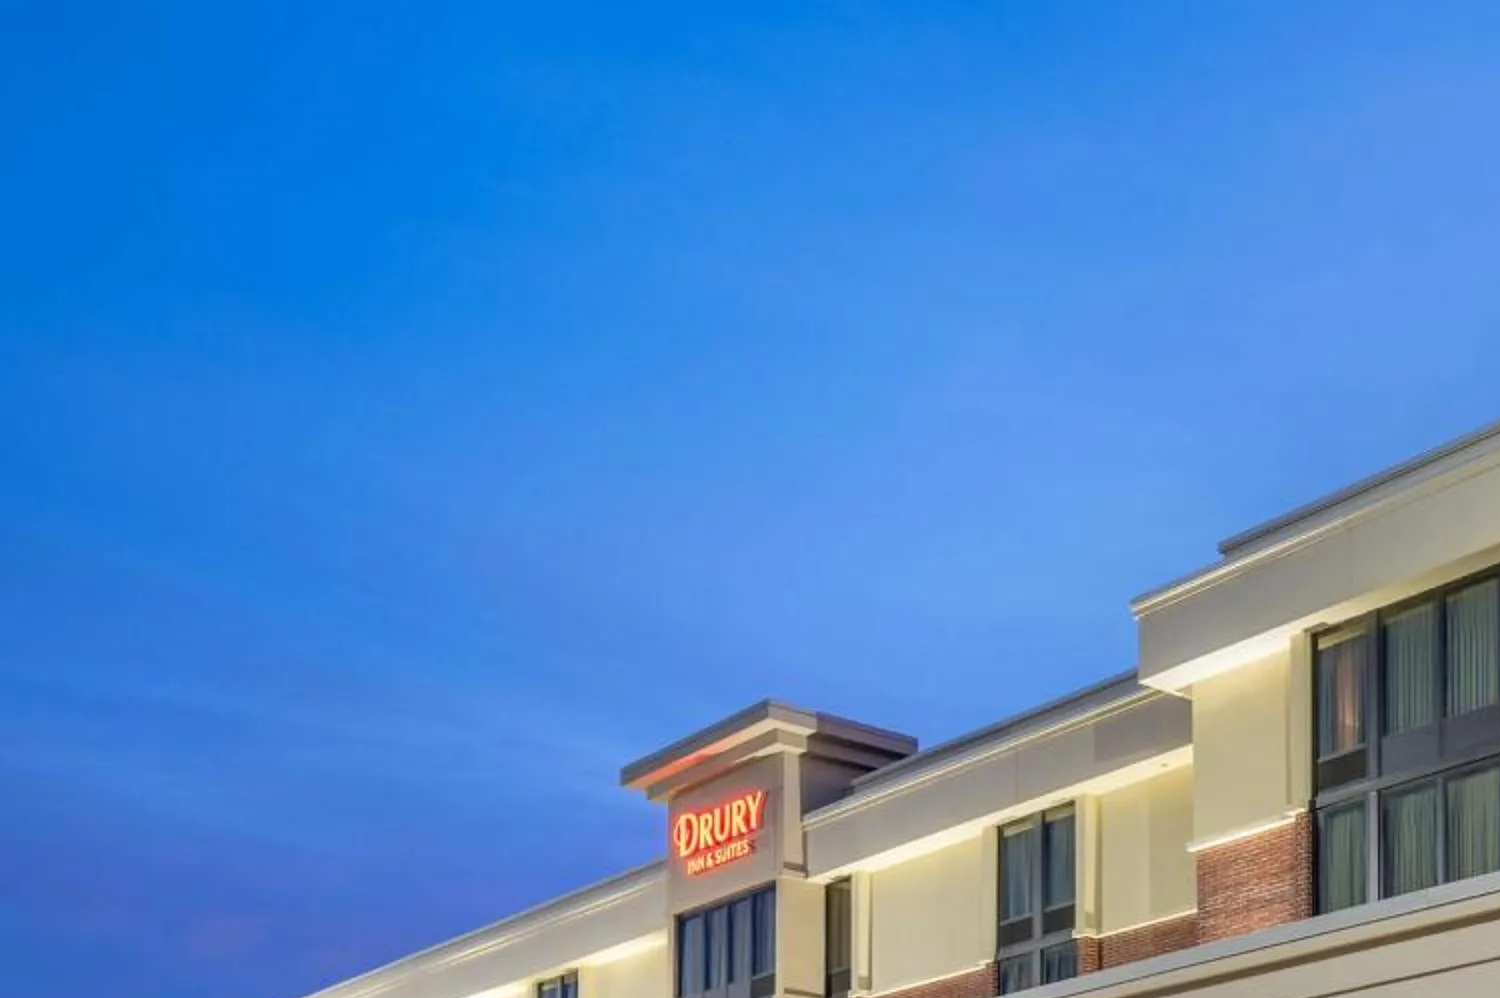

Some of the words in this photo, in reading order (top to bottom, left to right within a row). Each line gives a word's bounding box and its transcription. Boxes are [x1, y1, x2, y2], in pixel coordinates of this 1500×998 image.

[674, 790, 762, 857] DRURY
[687, 855, 705, 875] INN
[716, 839, 749, 865] SUITES
